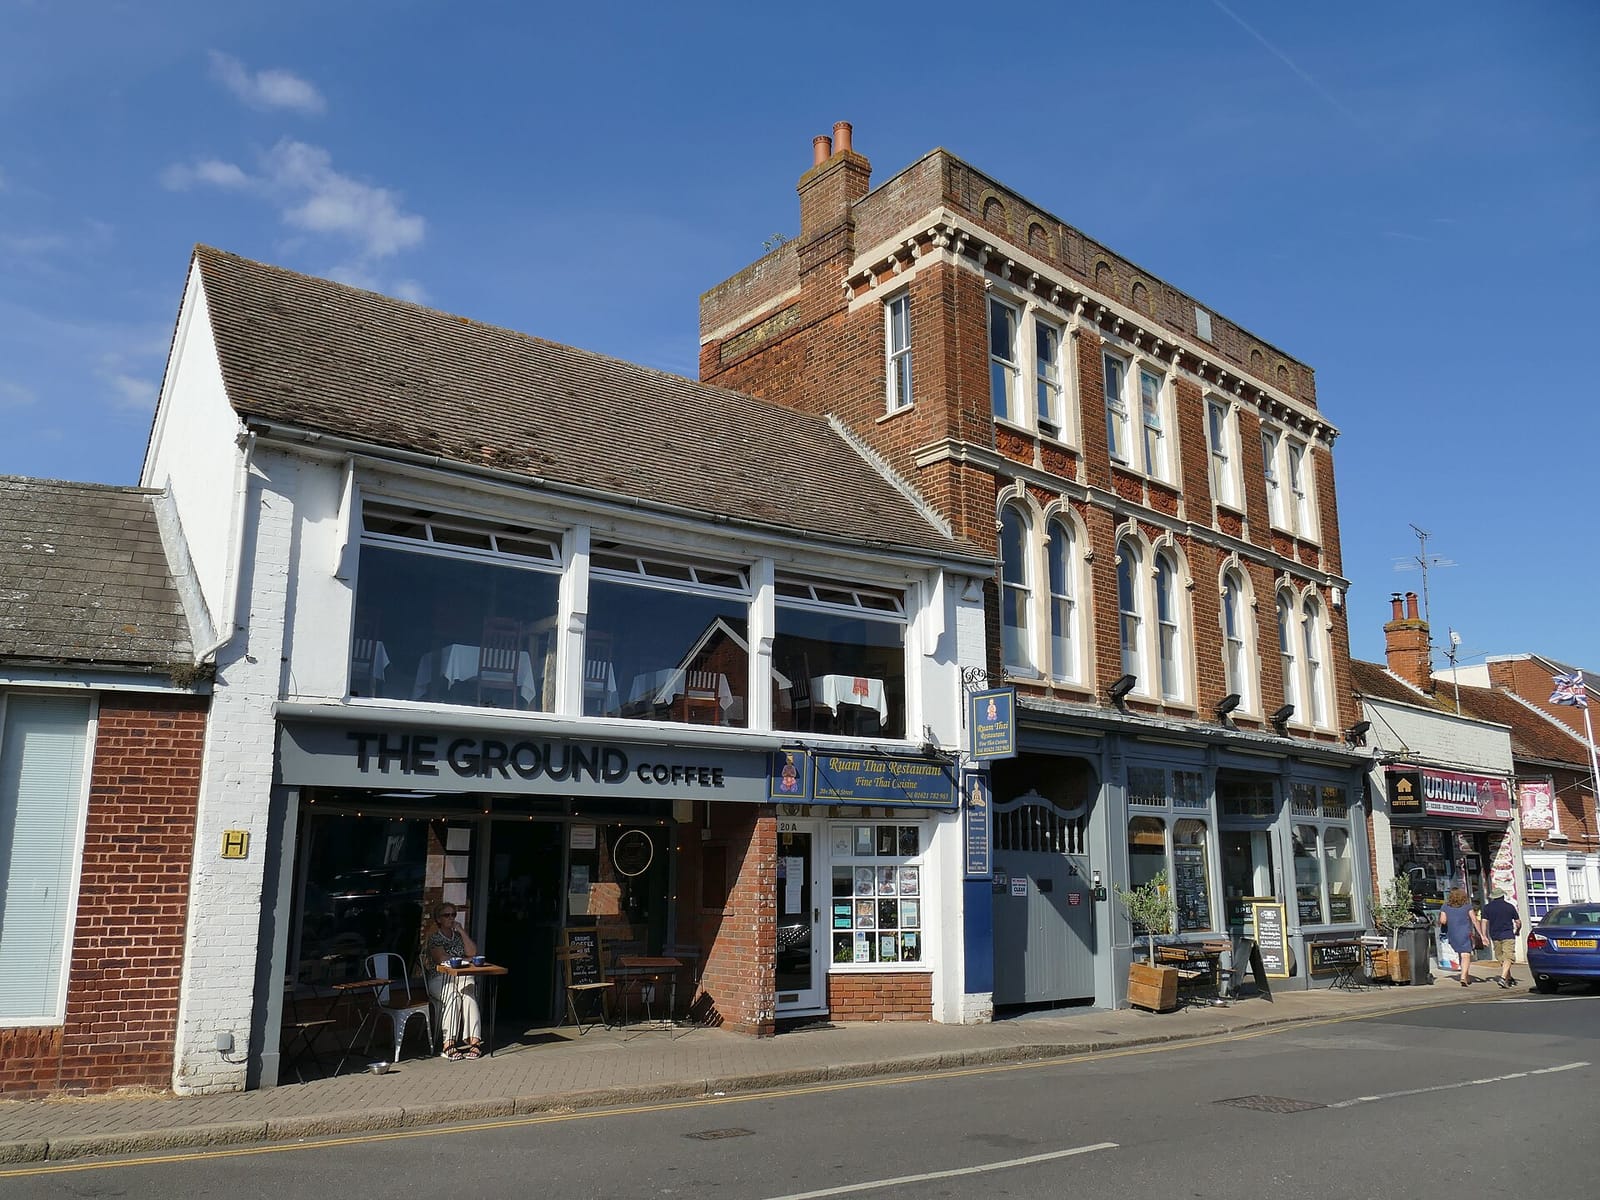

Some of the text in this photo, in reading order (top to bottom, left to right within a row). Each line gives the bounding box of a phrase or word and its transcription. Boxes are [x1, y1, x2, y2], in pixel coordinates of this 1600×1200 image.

[347, 732, 725, 788] THE GROUND COFFEE
[829, 757, 942, 776] Ruam Thai Restaurant
[855, 776, 918, 789] Fine Thai Cuisine
[780, 822, 790, 831] 20
[225, 833, 244, 855] H
[1068, 865, 1079, 876] 22
